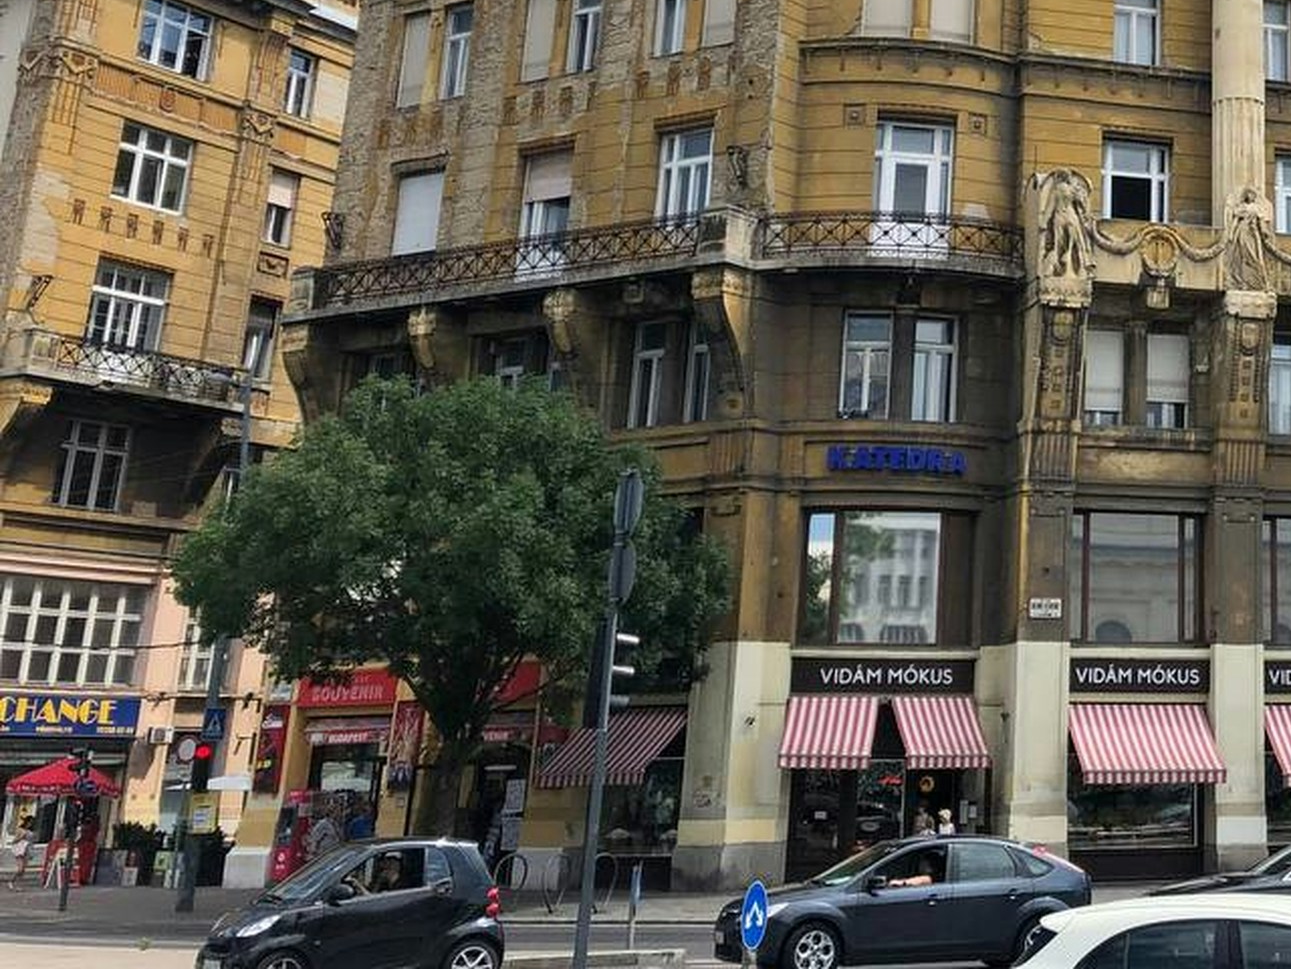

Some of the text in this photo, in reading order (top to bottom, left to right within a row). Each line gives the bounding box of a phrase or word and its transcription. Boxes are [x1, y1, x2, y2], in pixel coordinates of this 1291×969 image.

[827, 445, 967, 473] KATEDRA
[820, 664, 953, 685] VIDÁM MÓKUS
[1075, 664, 1200, 685] VIDÁM MÓKUS
[311, 684, 384, 702] SOUVENIR
